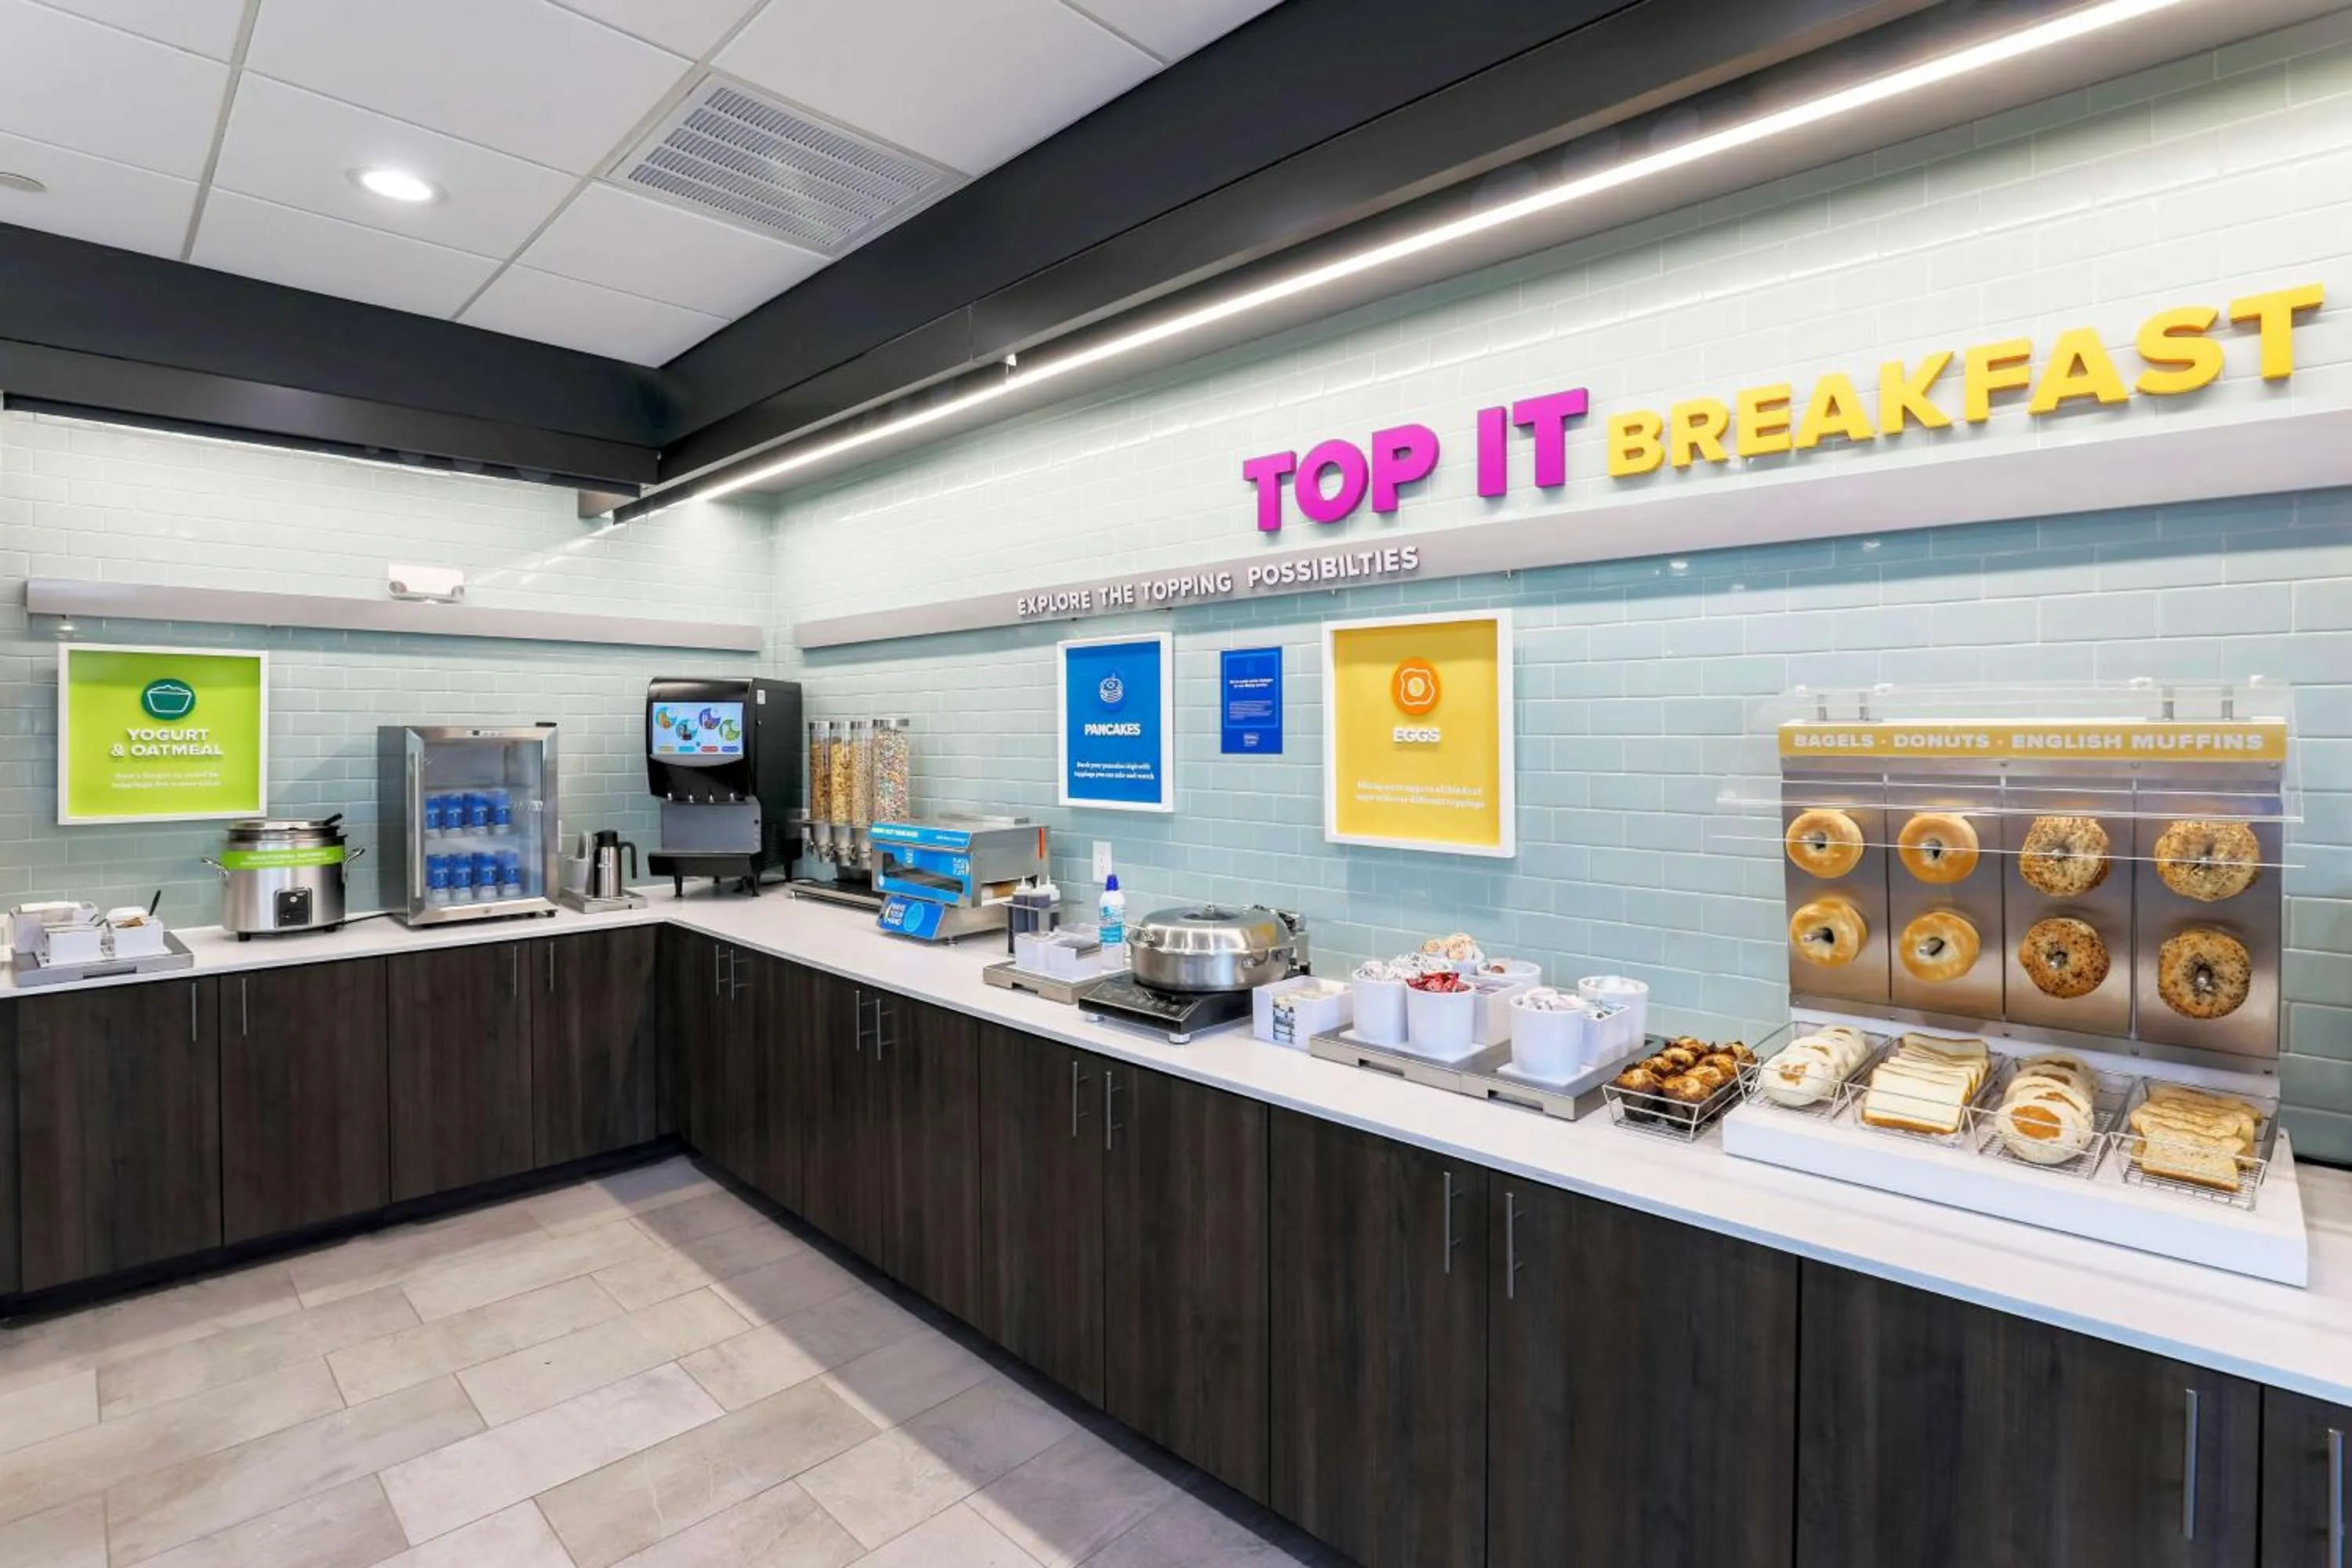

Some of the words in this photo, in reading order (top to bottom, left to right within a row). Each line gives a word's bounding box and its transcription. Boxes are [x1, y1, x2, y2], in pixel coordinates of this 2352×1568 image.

[1243, 423, 1440, 532] TOP
[1477, 387, 1589, 497] IT
[1607, 282, 2326, 478] BREAKFAST
[1017, 590, 1091, 615] EXPLORE
[1099, 584, 1134, 607] THE
[1142, 572, 1232, 601] TOPPING
[1247, 545, 1419, 588] POSSIBILTIES
[126, 728, 209, 742] YOGURT
[1084, 724, 1142, 736] PANCAKES
[1392, 727, 1442, 742] EGGS
[1794, 733, 1875, 748] BAGELS
[1893, 733, 1991, 749] DONUTS
[2011, 734, 2122, 749] ENGLISH
[2131, 734, 2264, 750] MUFFINS
[111, 743, 125, 757] &
[131, 744, 223, 757] OATMEAL
